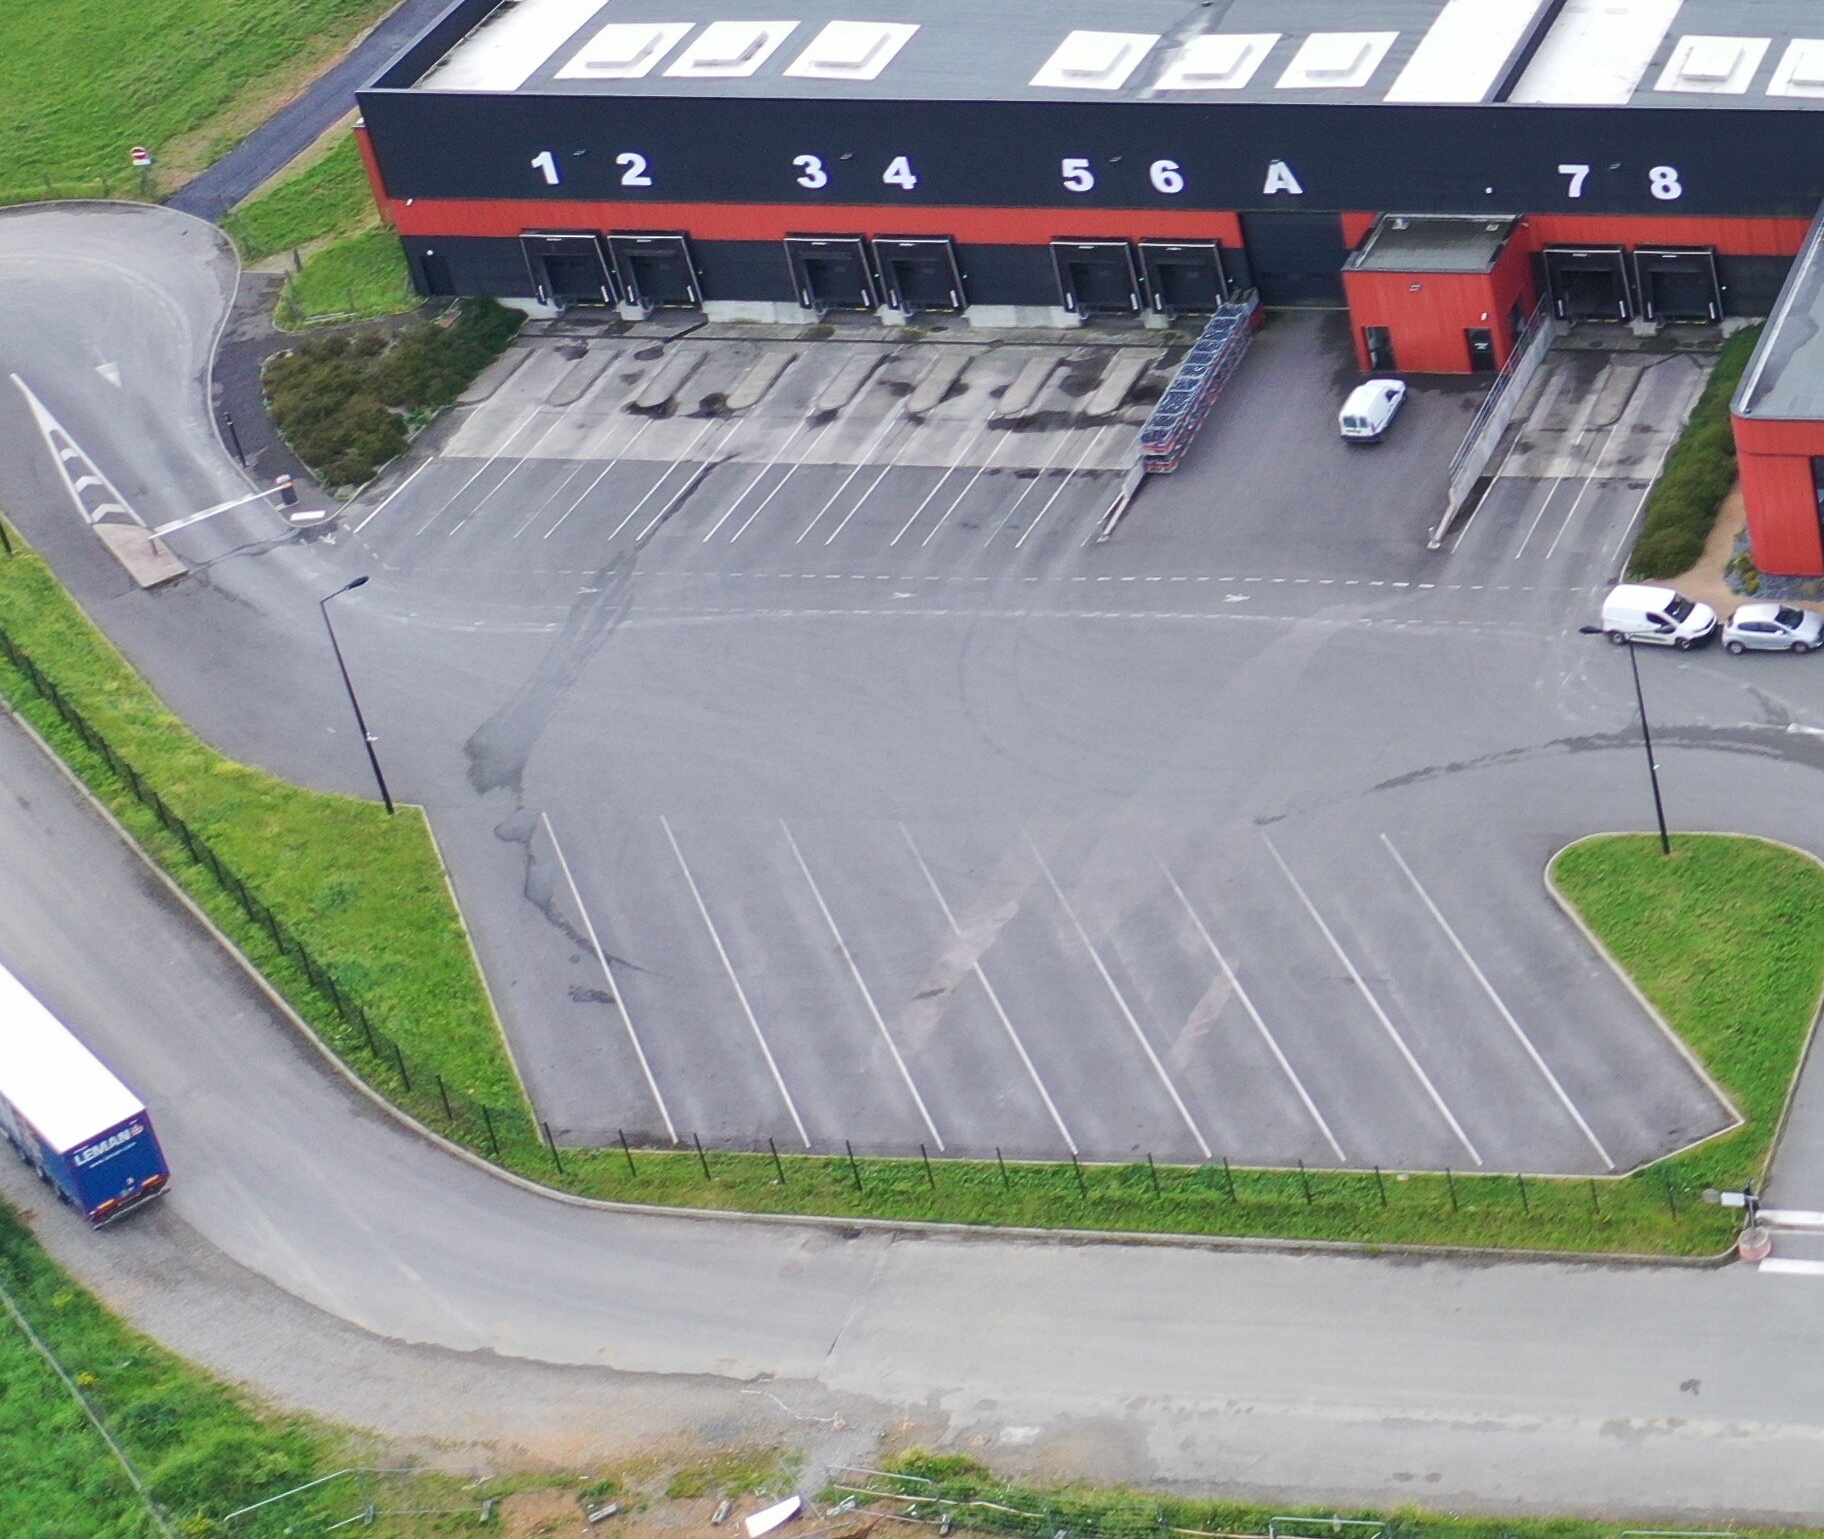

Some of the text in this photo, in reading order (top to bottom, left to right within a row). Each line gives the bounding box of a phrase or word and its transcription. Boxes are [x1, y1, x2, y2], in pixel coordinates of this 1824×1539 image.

[531, 151, 559, 185] 1
[615, 152, 652, 186] 2
[792, 154, 828, 189] 3
[882, 156, 917, 190] 4
[1062, 158, 1094, 192] 5
[1149, 159, 1184, 194] 6
[1263, 161, 1304, 194] A
[1558, 164, 1590, 198] 7
[1648, 165, 1682, 200] 8
